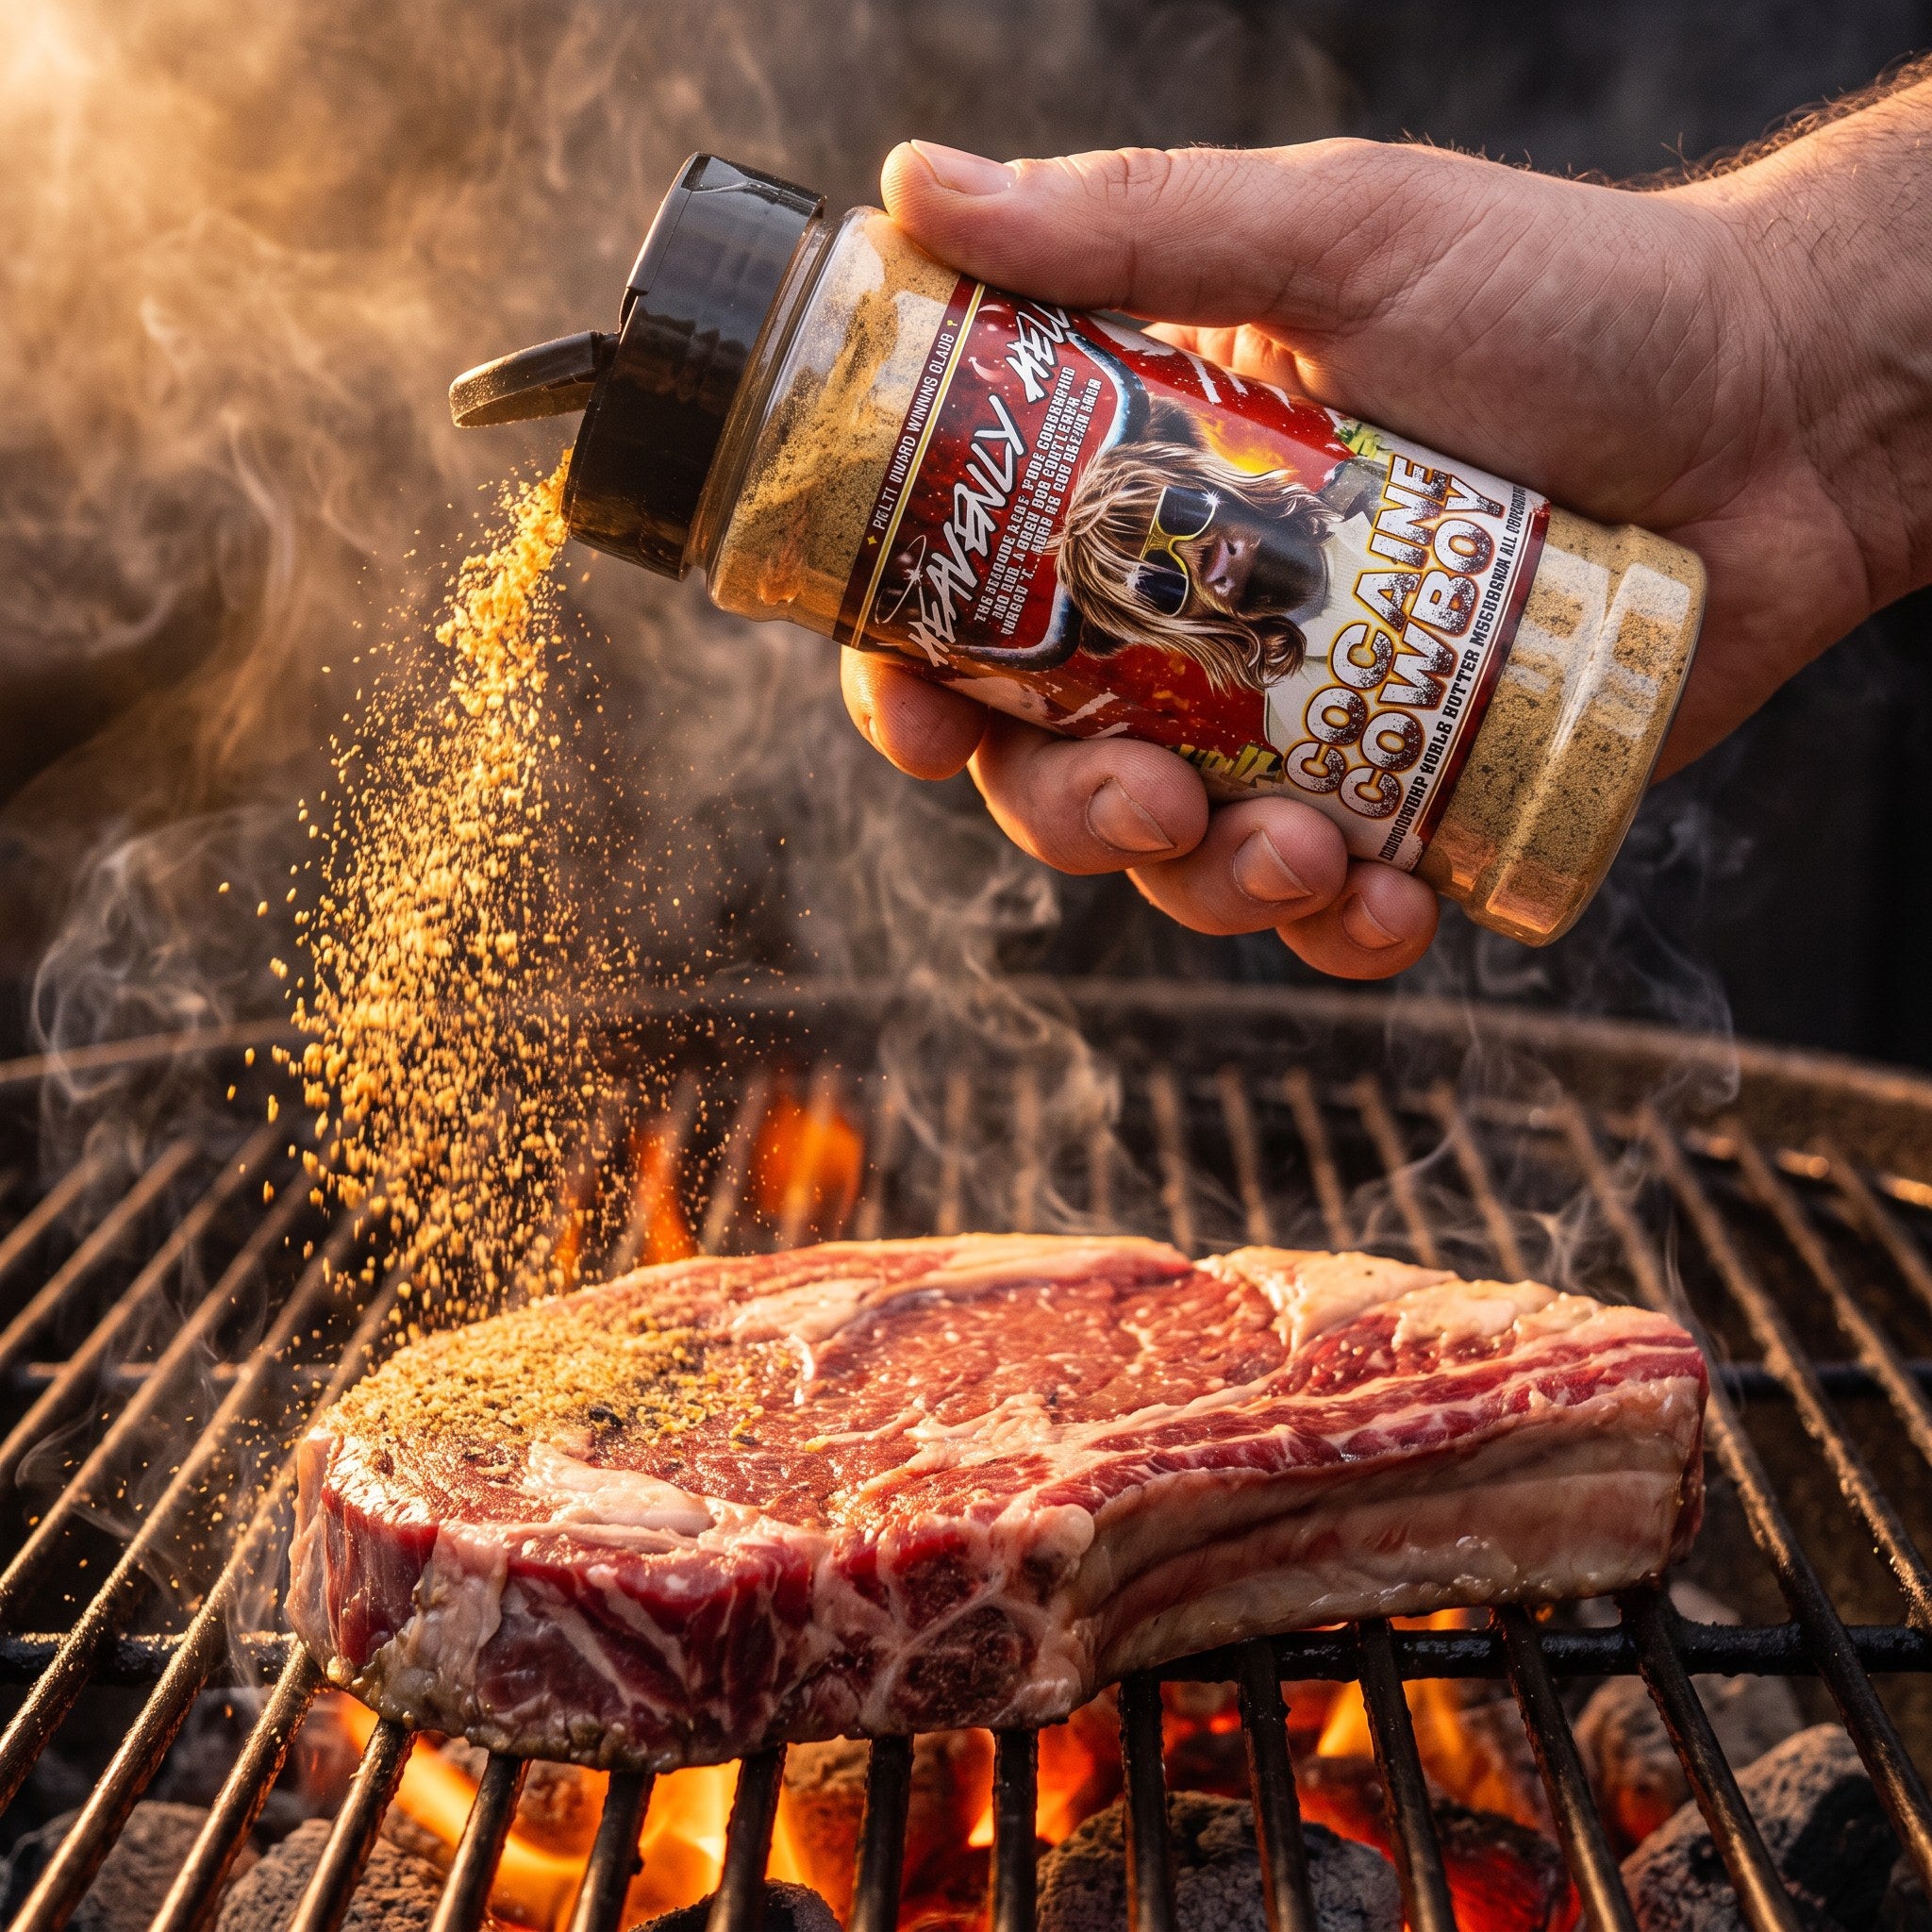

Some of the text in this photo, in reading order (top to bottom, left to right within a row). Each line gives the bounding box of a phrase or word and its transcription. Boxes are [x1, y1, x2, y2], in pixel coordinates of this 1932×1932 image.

[904, 394, 1024, 666] HEAVENLY
[1286, 454, 1451, 795] COCAINE
[1338, 475, 1506, 820] COWBOY
